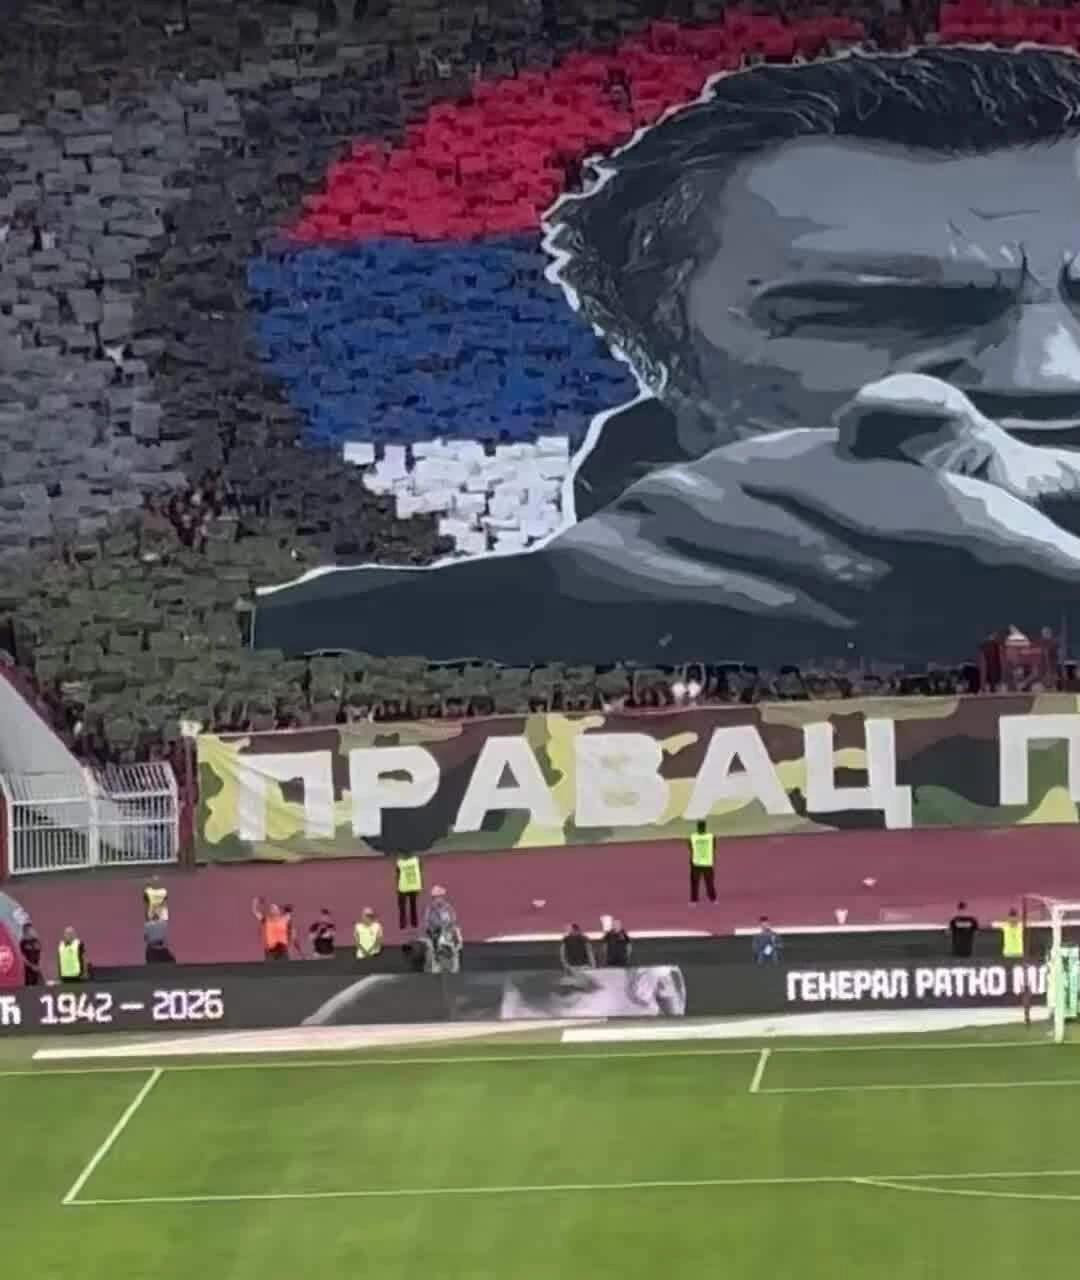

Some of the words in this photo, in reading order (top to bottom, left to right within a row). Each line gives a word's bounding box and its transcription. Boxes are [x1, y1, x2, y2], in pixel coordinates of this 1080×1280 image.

[235, 718, 912, 841] ПРАВАЦ
[786, 968, 908, 1001] ГЕНЕРАЛ
[915, 966, 1006, 998] РАТКО
[39, 992, 113, 1024] 1942
[152, 988, 225, 1020] 2026
